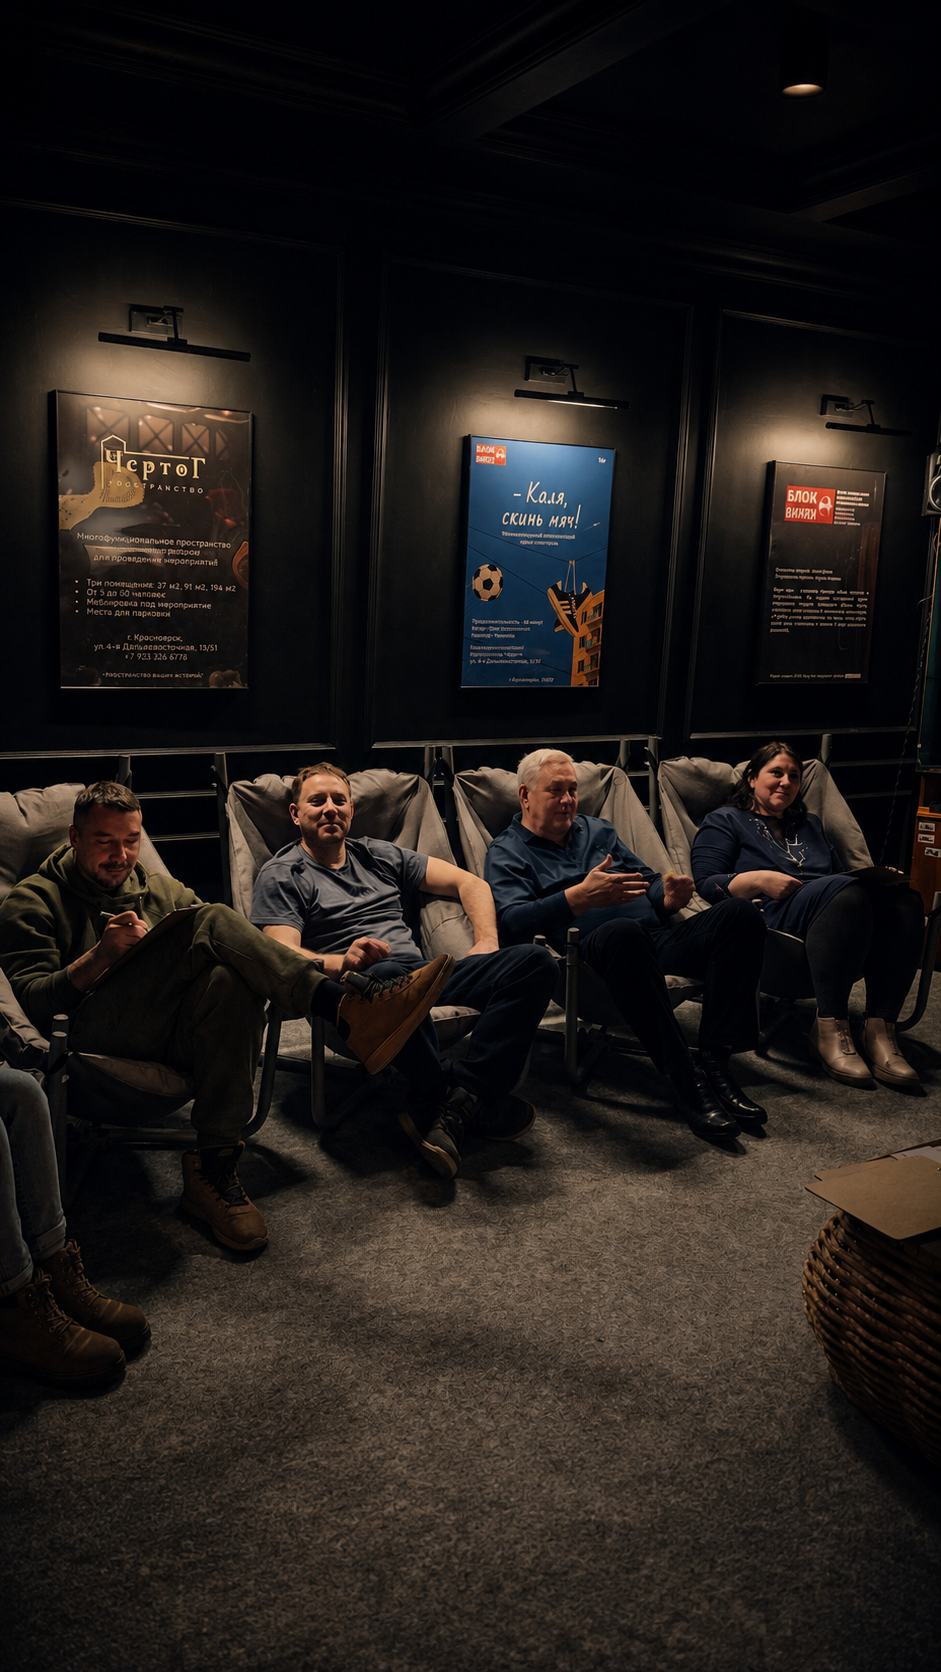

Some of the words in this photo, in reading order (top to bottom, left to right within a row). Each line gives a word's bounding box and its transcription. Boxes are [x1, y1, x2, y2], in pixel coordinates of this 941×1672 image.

[787, 490, 817, 504] БЛОК
[502, 511, 543, 526] скинь
[548, 504, 581, 529] мяч!
[176, 539, 231, 549] пространство
[86, 579, 102, 587] Три
